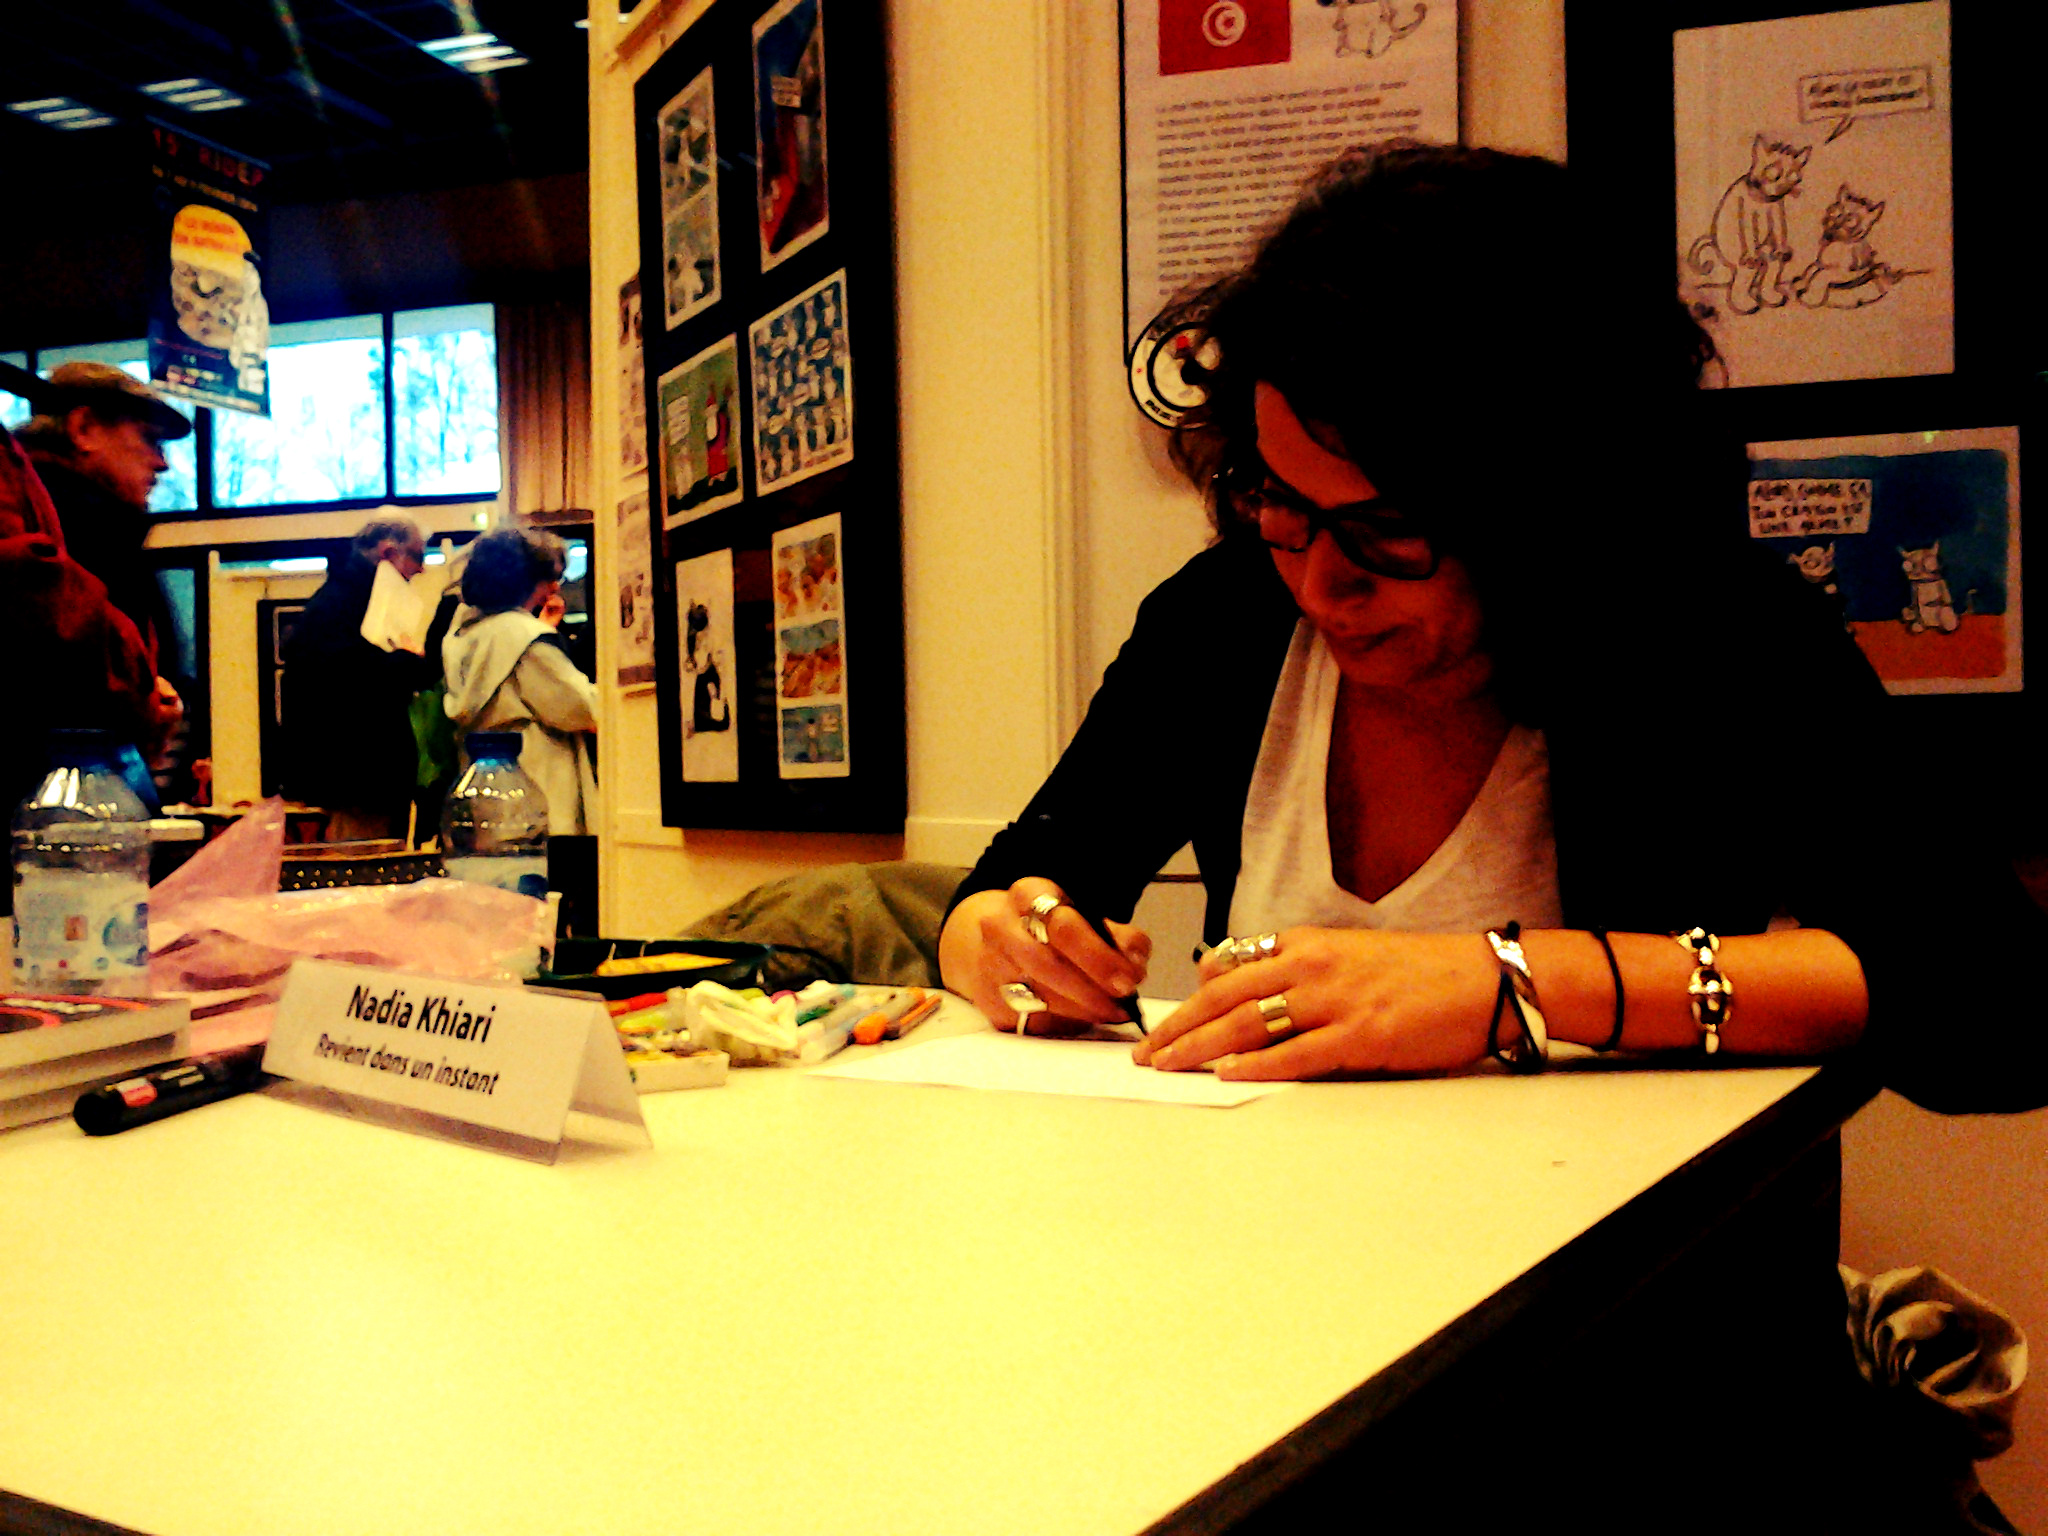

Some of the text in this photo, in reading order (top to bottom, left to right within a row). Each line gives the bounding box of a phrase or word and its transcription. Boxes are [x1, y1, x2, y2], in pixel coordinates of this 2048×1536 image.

[347, 985, 496, 1044] Nadia Khiari
[315, 1033, 500, 1096] Revient dans un instant
